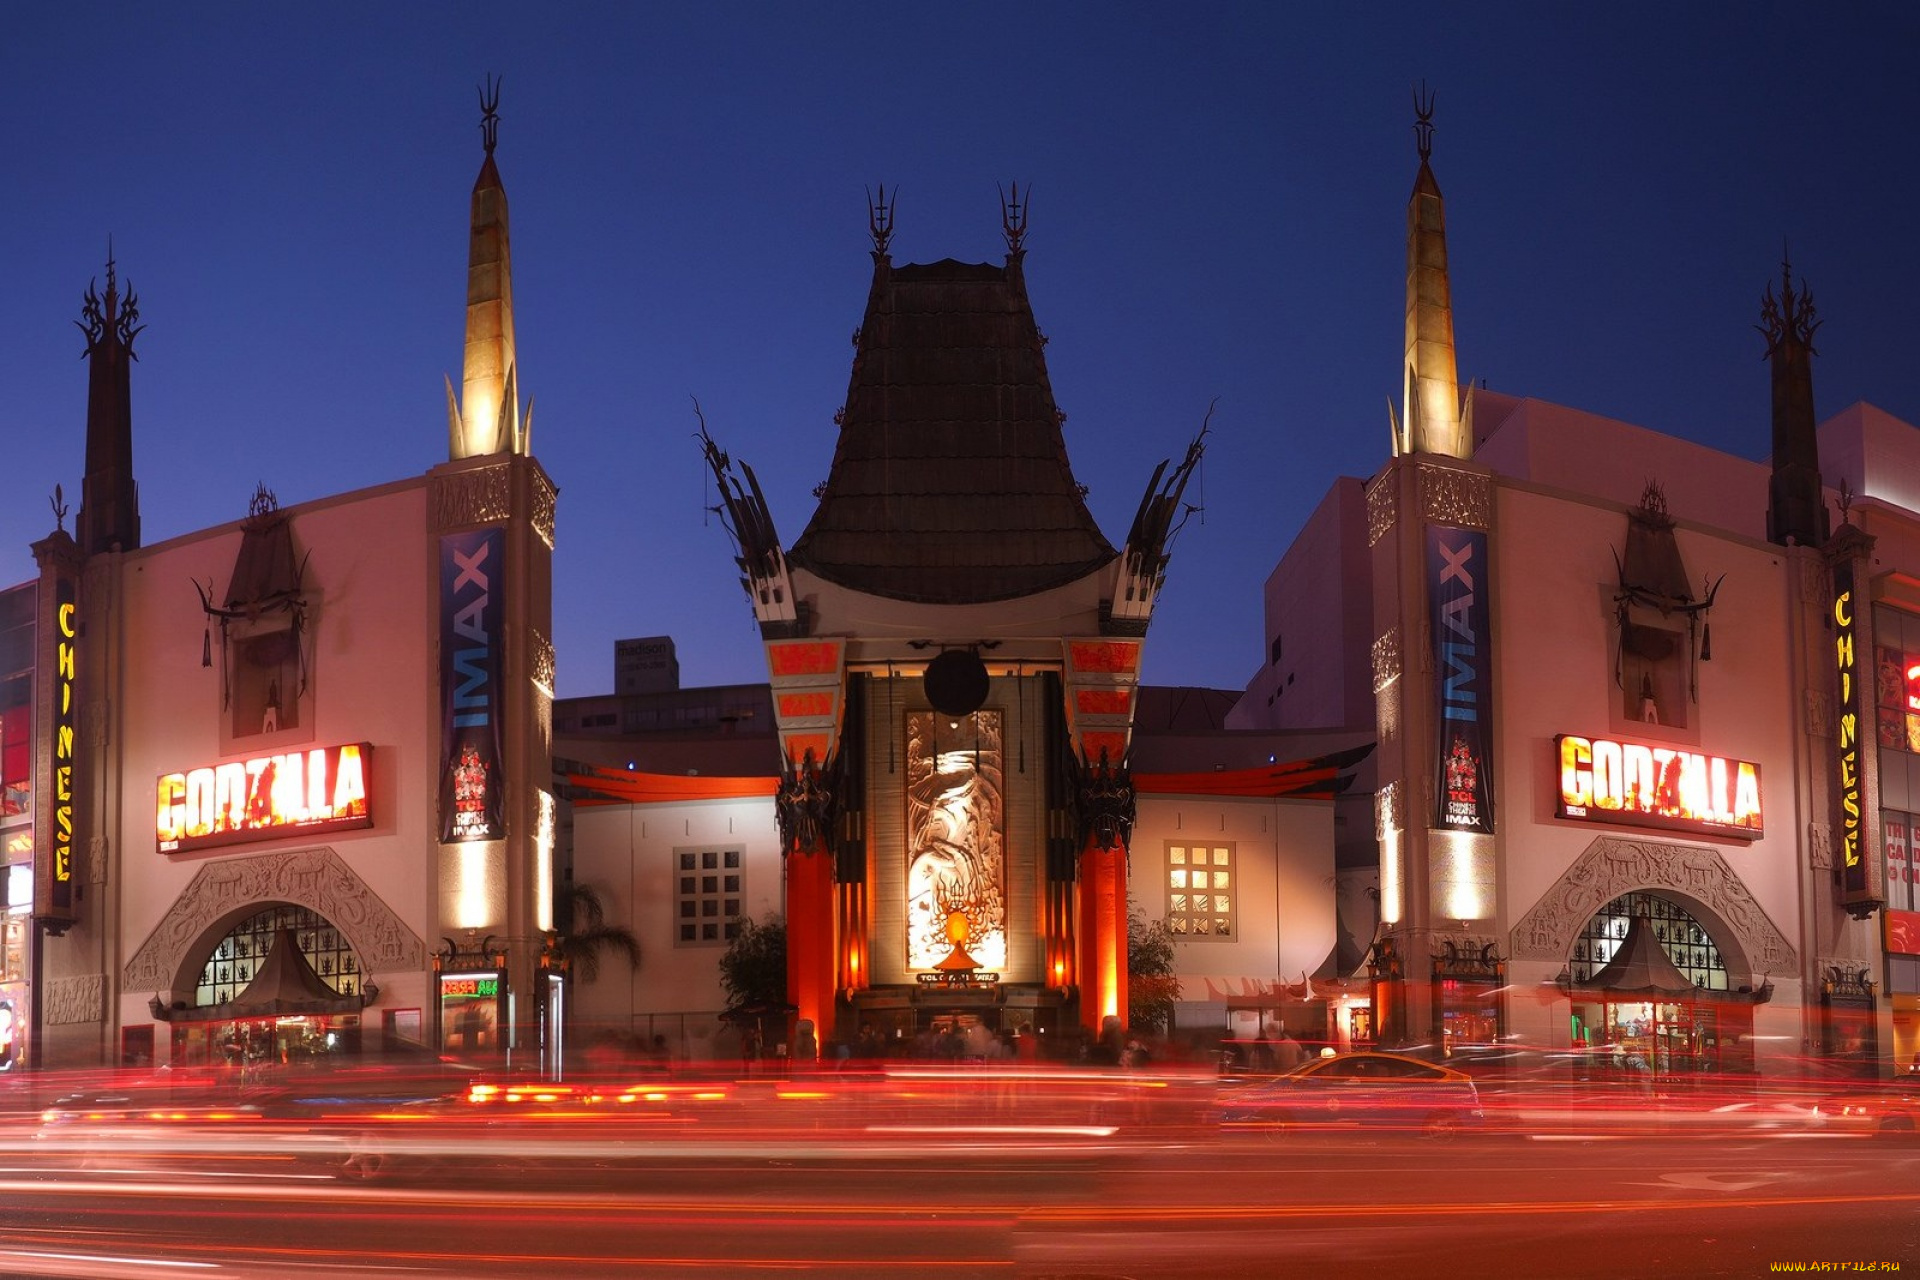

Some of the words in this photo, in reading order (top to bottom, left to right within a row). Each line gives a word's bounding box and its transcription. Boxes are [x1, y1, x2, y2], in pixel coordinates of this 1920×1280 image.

[454, 541, 488, 728] IMAX
[1439, 541, 1476, 722] IMAX
[56, 603, 75, 881] CHINESE
[1836, 591, 1859, 867] CHINESE
[157, 745, 366, 842] GODZILLA
[456, 800, 485, 811] TCL
[1445, 814, 1481, 825] IMAX
[1448, 790, 1476, 803] TCL
[1560, 736, 1762, 828] GODZILLA
[453, 824, 489, 836] IMAX
